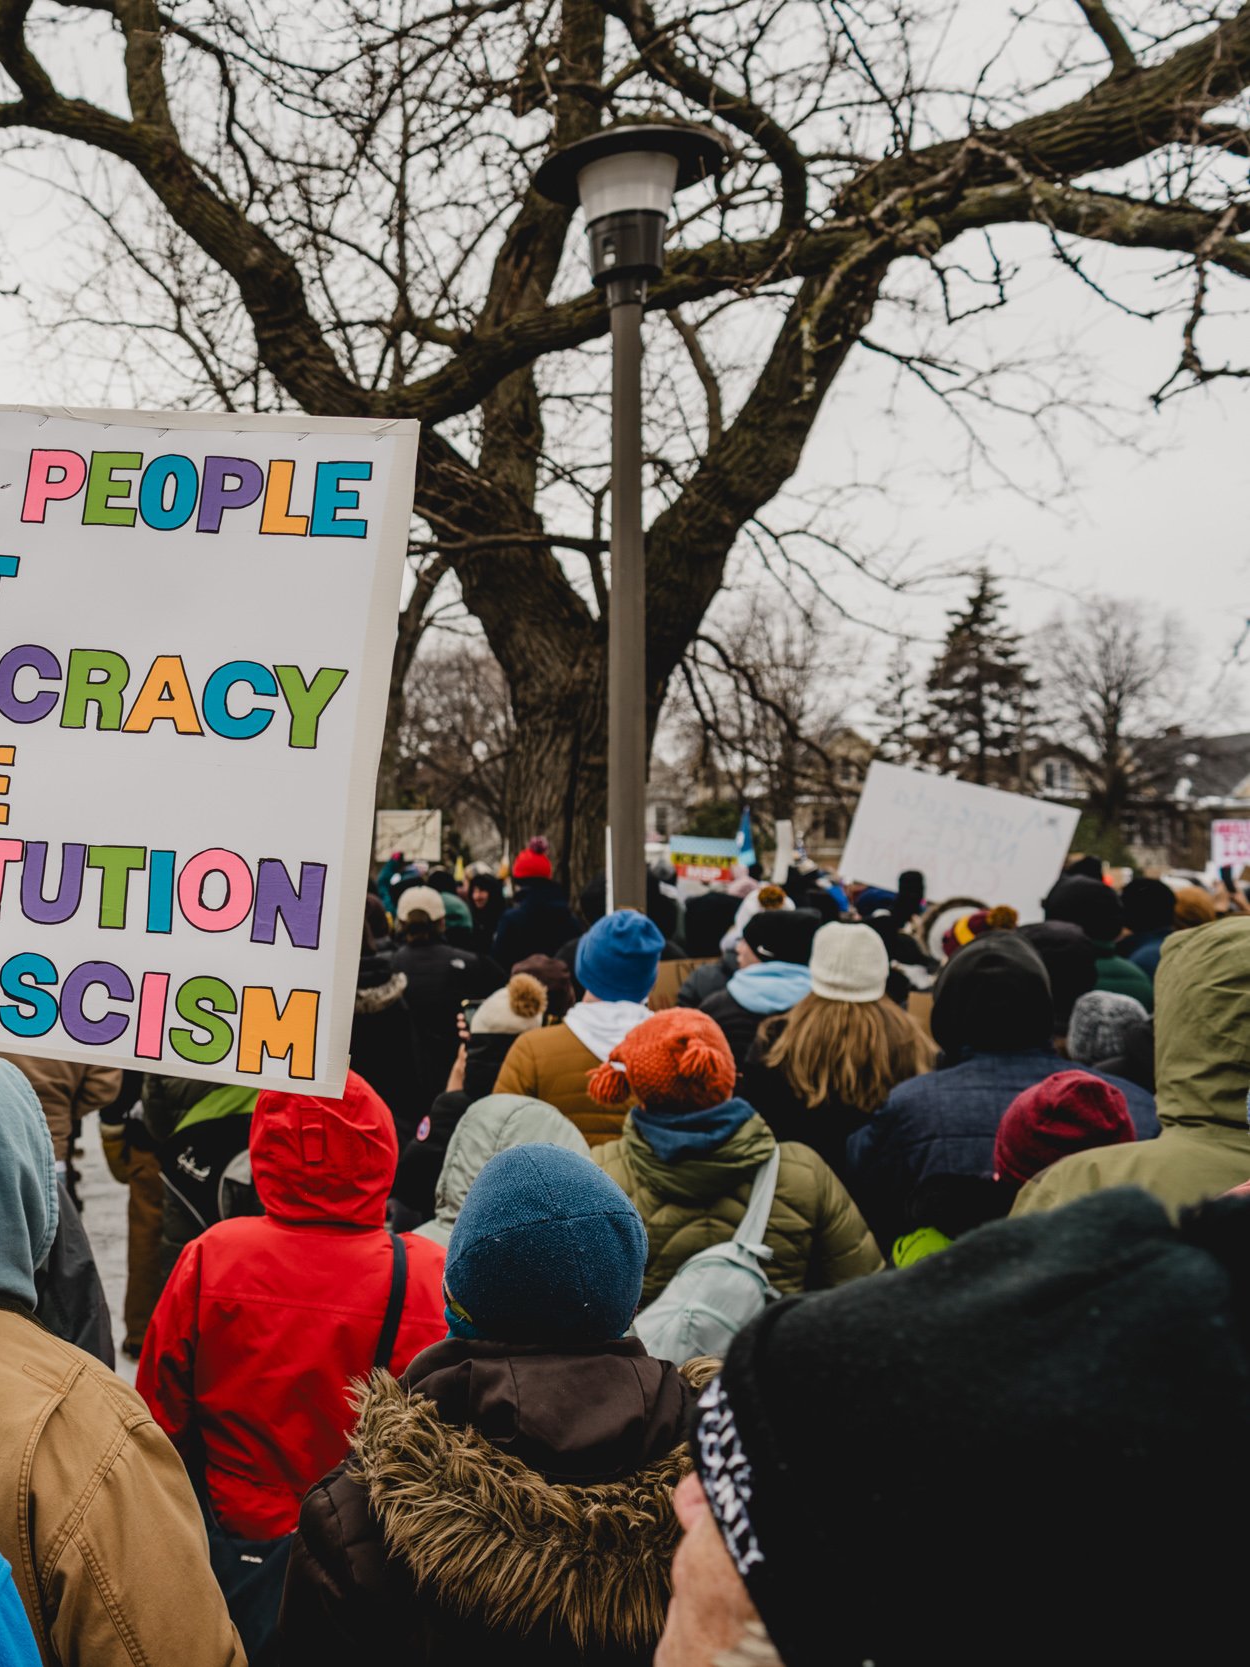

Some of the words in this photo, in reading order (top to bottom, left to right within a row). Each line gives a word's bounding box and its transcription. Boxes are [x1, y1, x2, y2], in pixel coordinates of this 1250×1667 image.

[21, 448, 373, 538] PEOPLE
[675, 854, 698, 865] ICE
[703, 855, 733, 868] OUT
